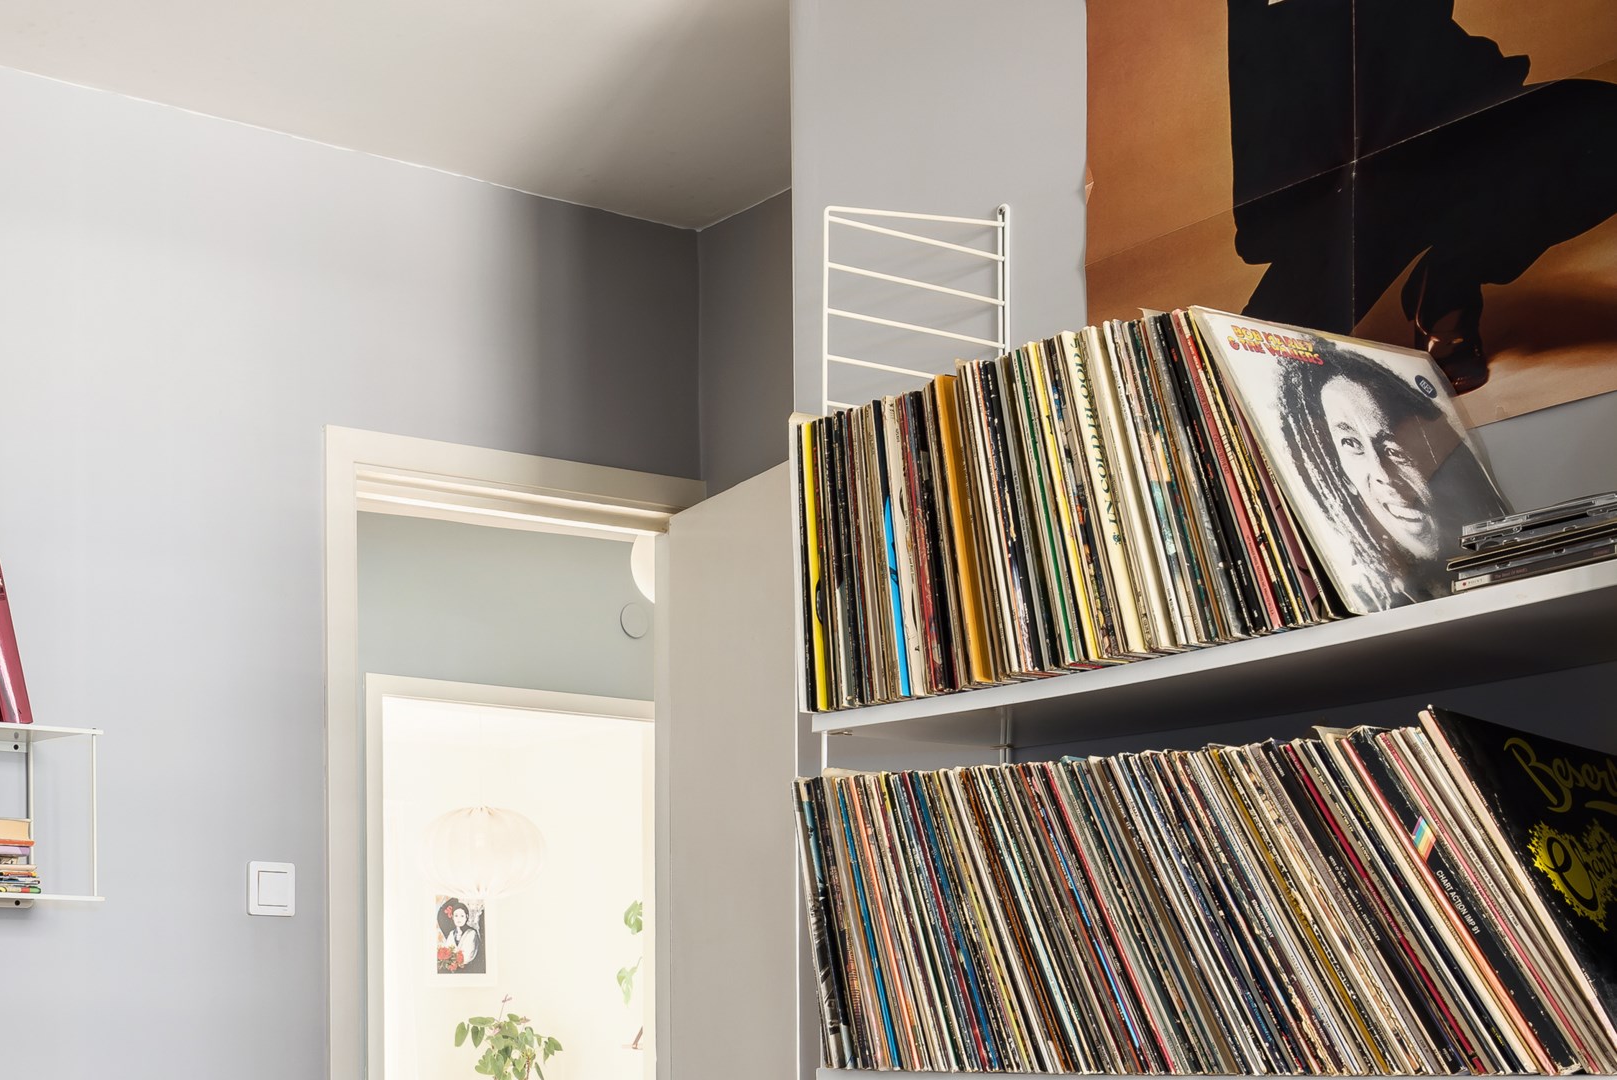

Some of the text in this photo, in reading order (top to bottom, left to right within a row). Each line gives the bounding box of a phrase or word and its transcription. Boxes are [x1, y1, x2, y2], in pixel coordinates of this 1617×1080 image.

[1231, 325, 1314, 352] BOB MARLEY
[1239, 338, 1266, 354] THE
[1263, 343, 1324, 366] WAILERS
[1503, 737, 1617, 813] Beser
[1436, 869, 1481, 935] CHART ACTION IMP 91
